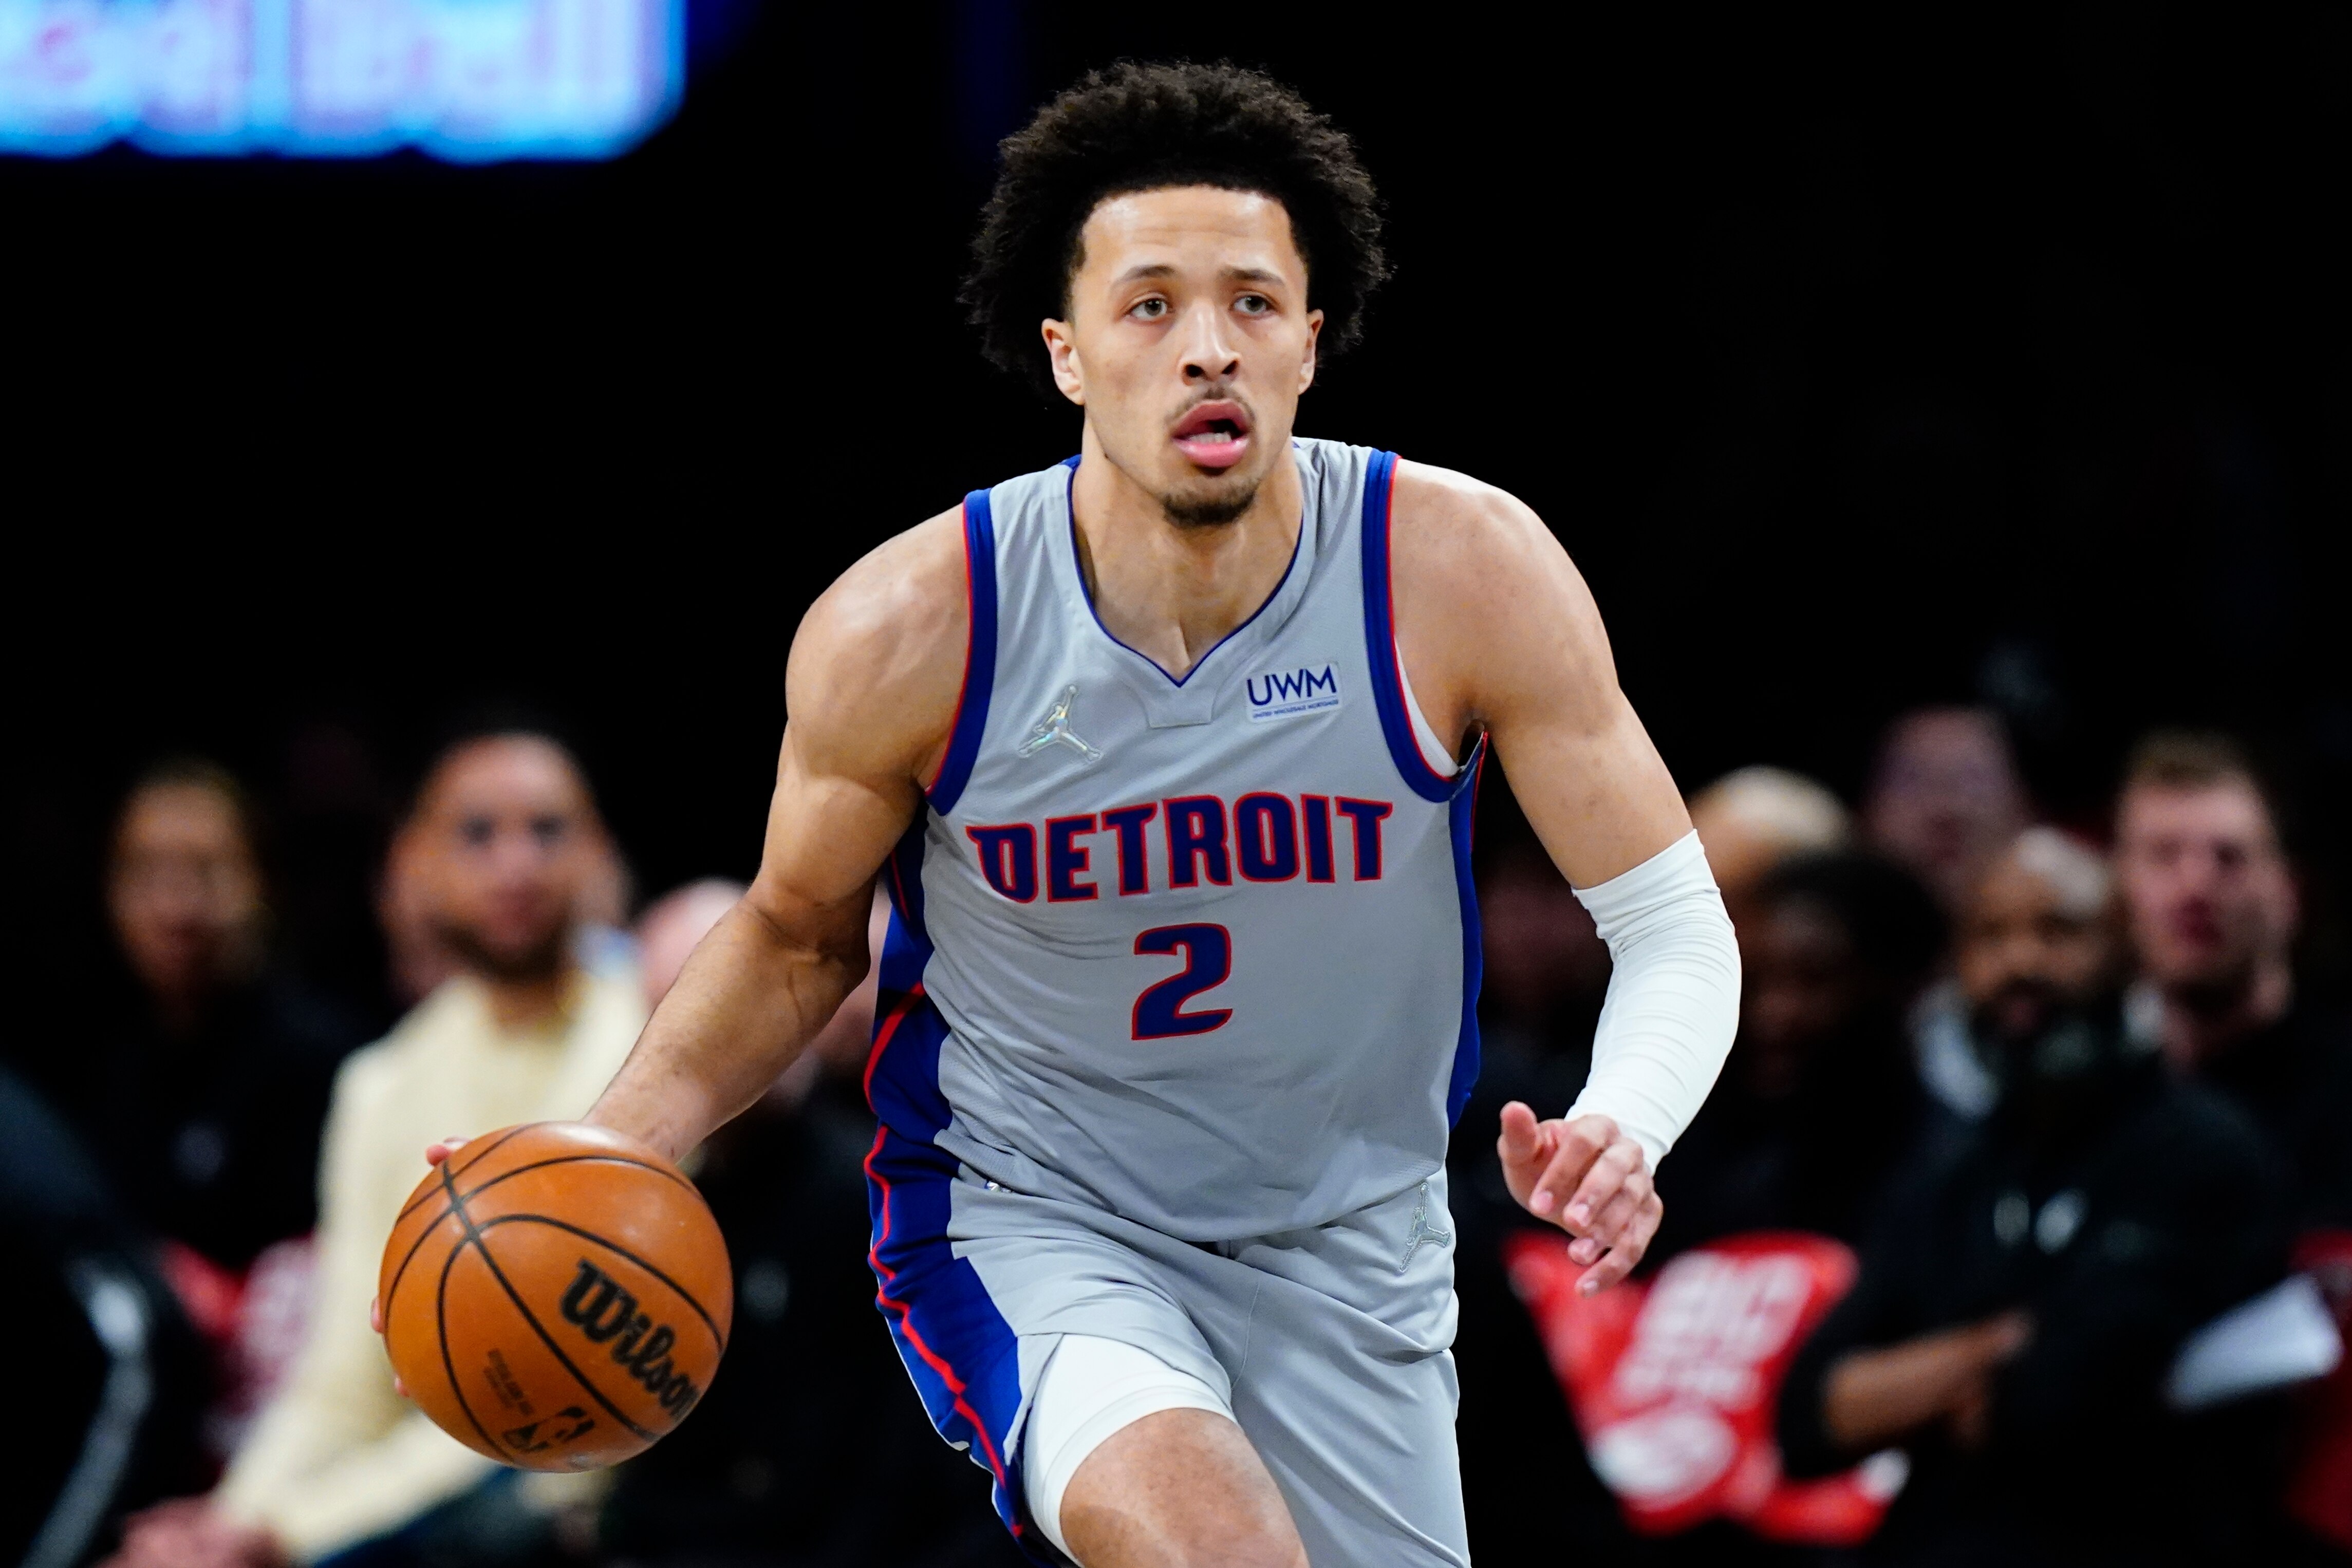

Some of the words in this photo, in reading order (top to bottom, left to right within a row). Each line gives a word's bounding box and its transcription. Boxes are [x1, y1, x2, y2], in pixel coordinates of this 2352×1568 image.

[1247, 665, 1336, 705] UWM
[966, 791, 1393, 903] DETROIT
[1131, 923, 1233, 1040] 2
